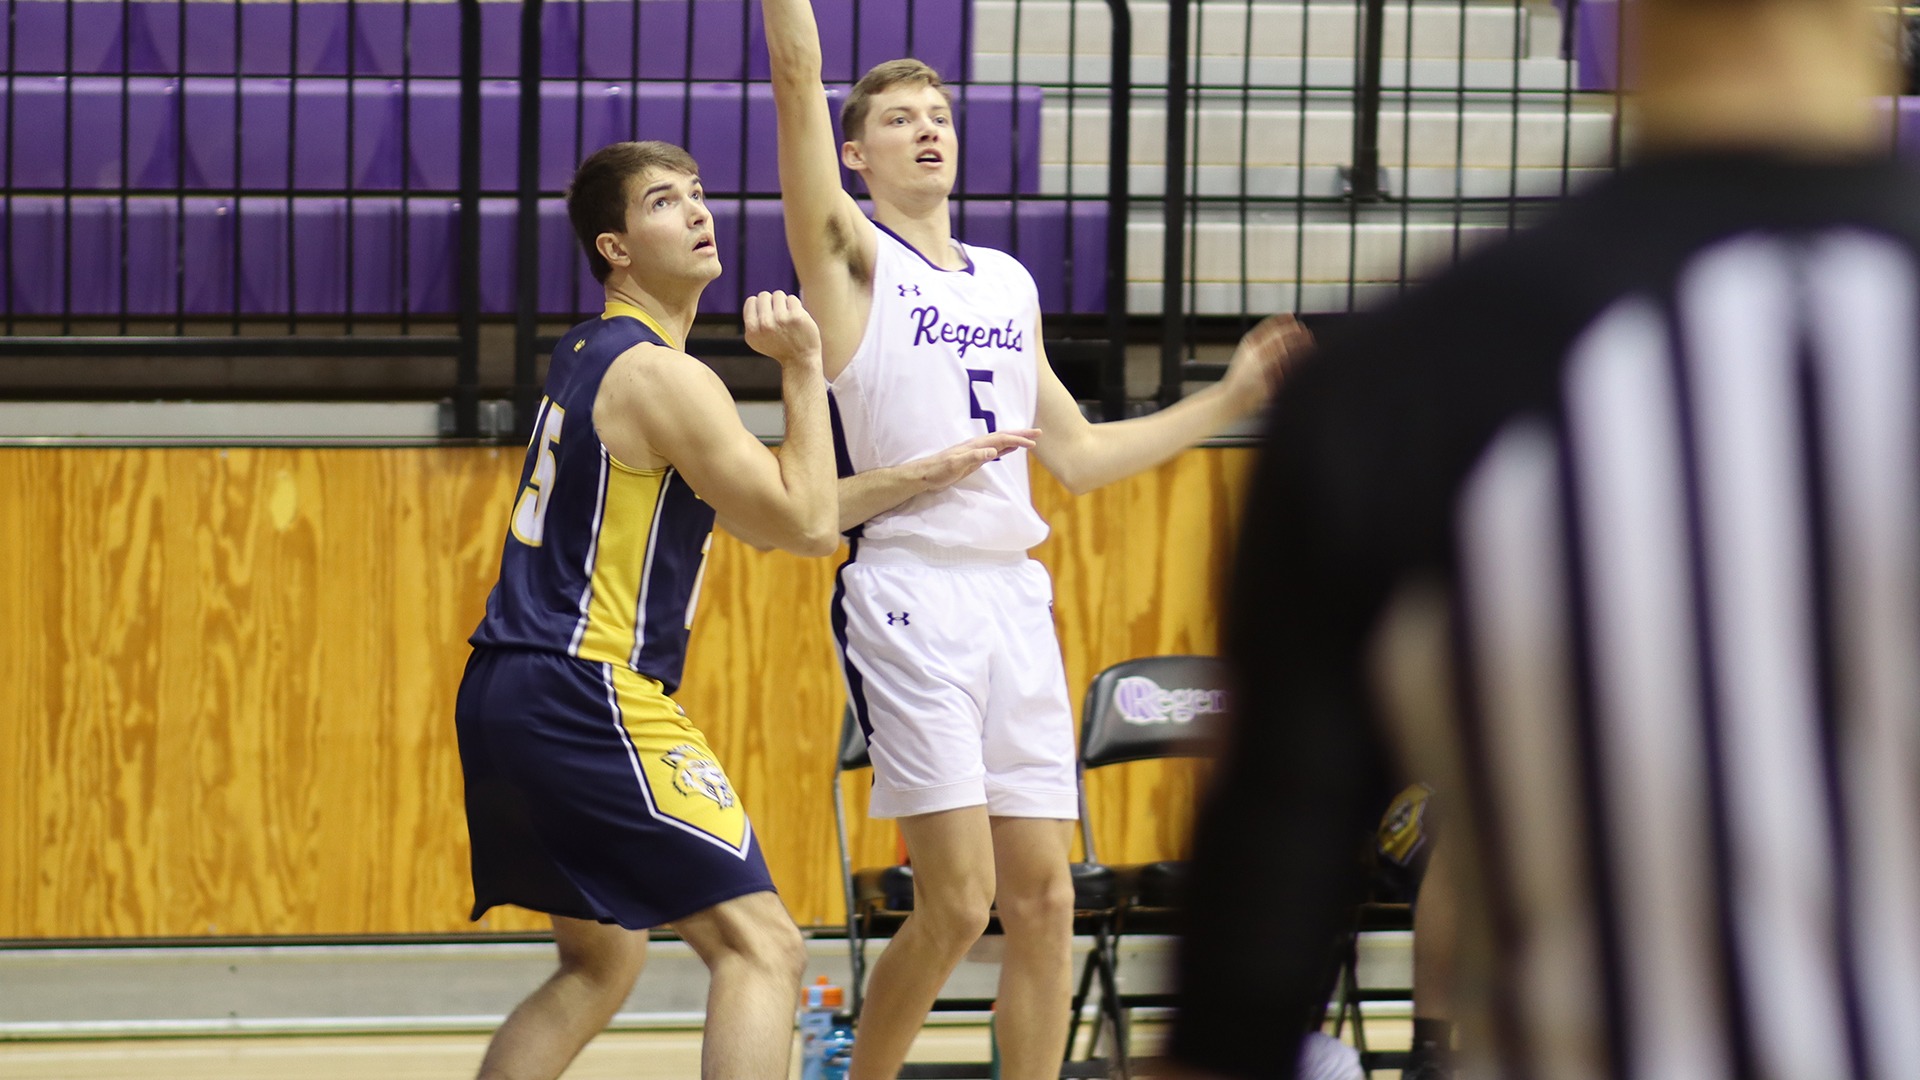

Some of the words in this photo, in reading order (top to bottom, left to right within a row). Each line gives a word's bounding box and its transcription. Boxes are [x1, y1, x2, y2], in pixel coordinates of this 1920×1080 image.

[911, 305, 1023, 359] Regents
[510, 395, 565, 547] 5
[1113, 675, 1230, 725] Regen
